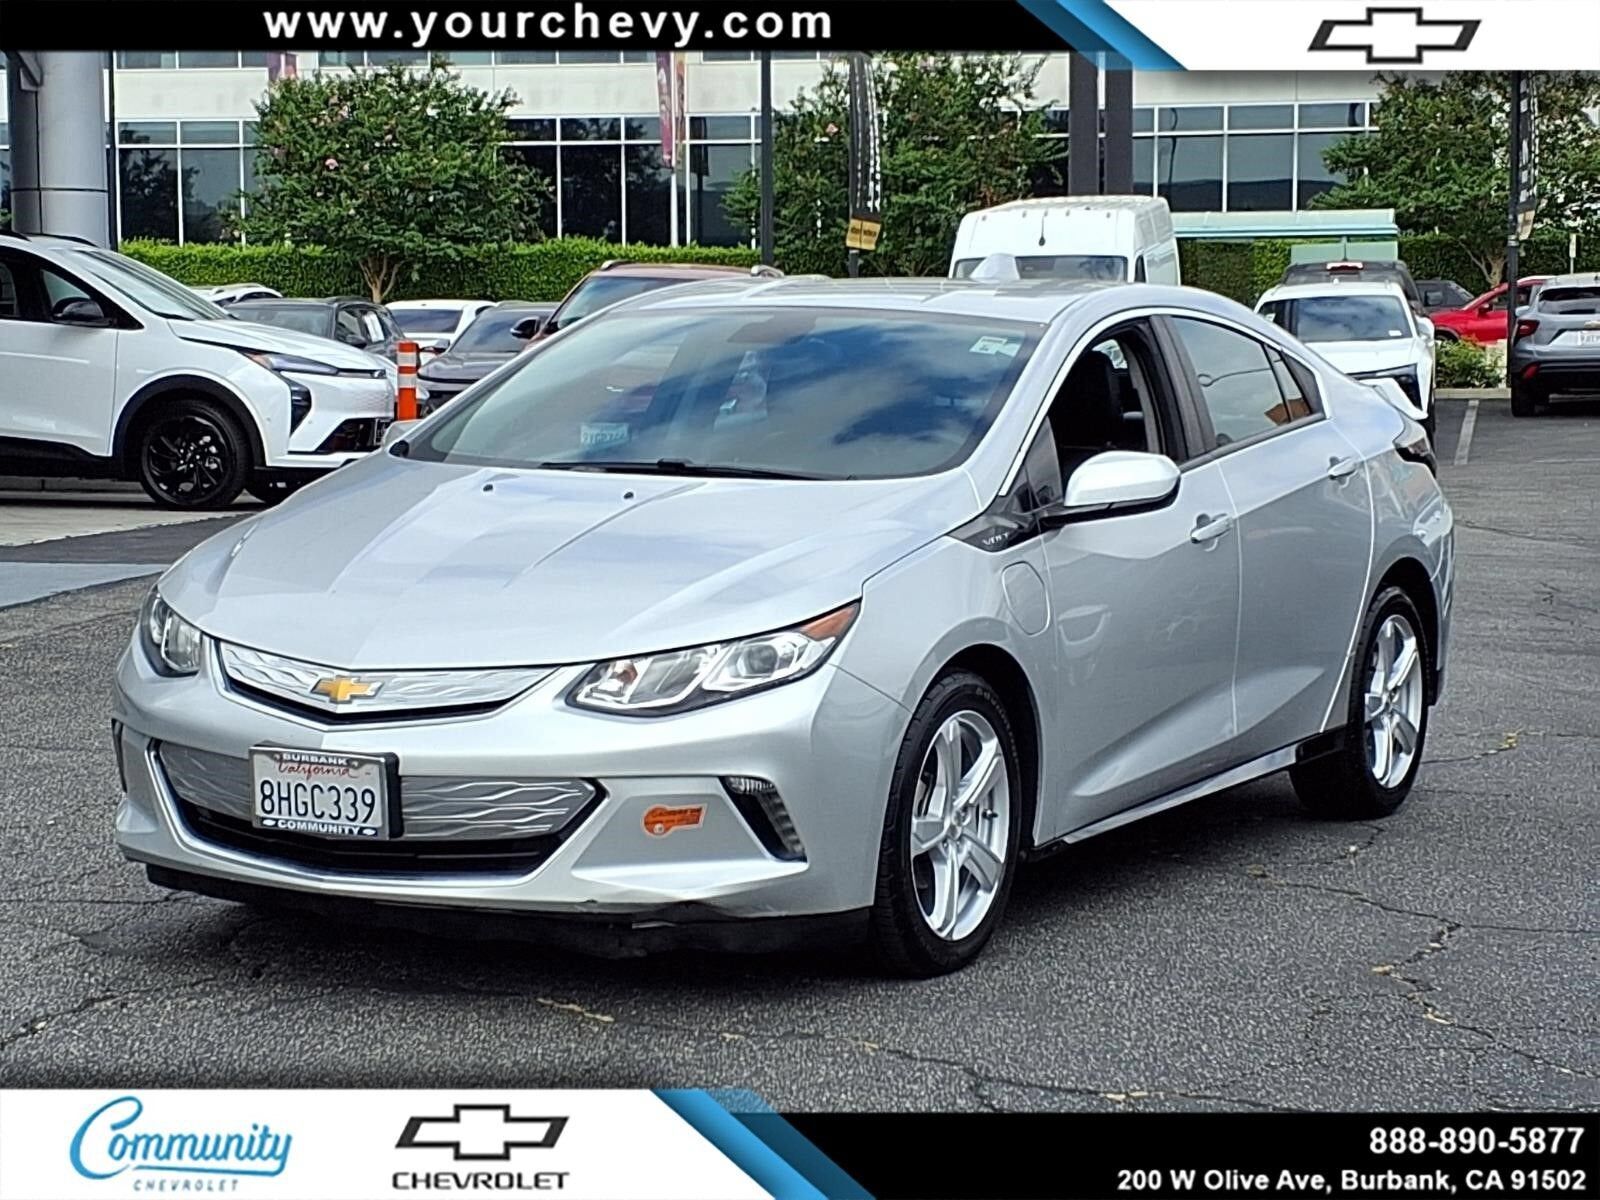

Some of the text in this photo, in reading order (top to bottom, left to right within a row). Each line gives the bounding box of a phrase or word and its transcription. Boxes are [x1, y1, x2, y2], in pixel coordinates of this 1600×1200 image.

[282, 753, 349, 766] BURBANK
[277, 760, 359, 780] California
[260, 780, 376, 823] 8HGC339
[277, 819, 360, 836] COMMUNITY
